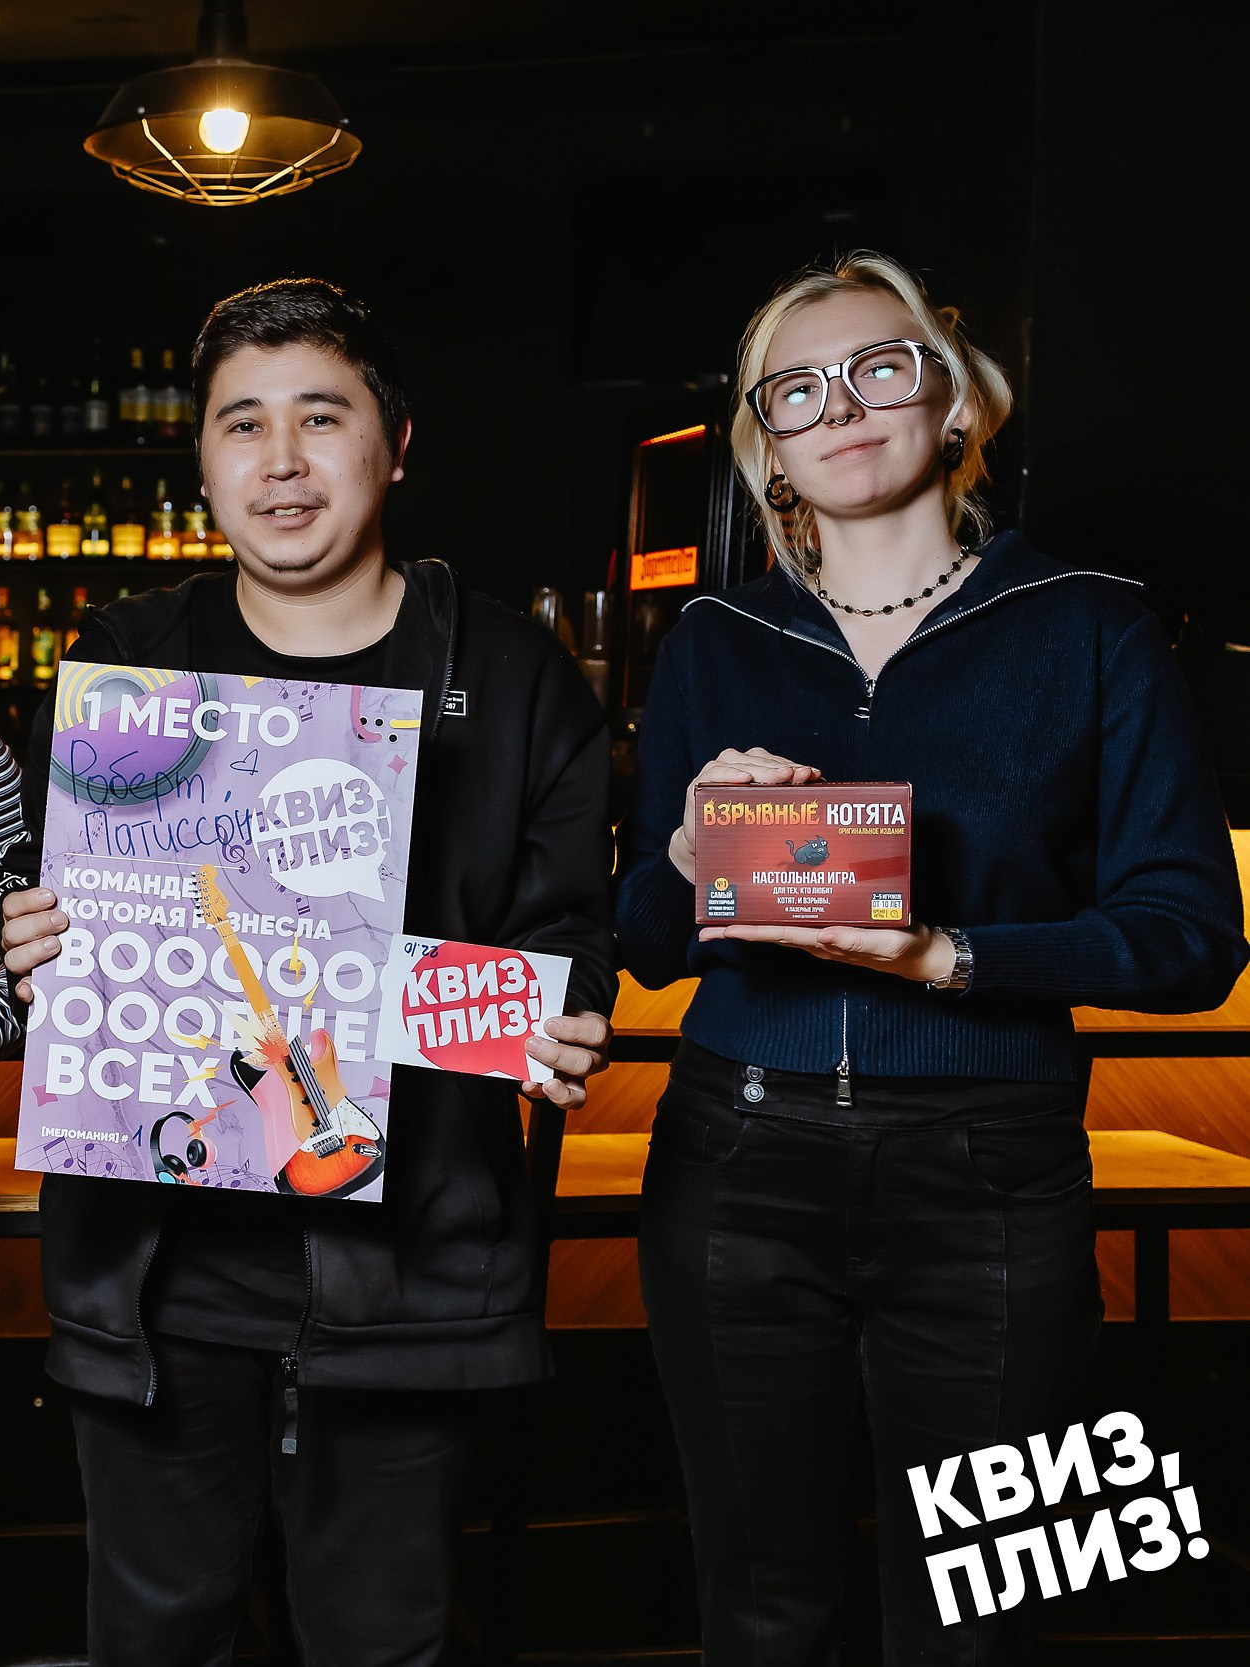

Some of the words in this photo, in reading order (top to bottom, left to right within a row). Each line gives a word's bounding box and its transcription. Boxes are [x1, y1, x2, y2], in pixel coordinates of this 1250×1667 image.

[84, 691, 102, 731] 1
[118, 694, 299, 747] МЕСТО
[258, 778, 387, 833] КВИЗ,
[703, 798, 820, 826] ВЗРЫВНЫЕ
[826, 802, 906, 825] КОТЯТА
[257, 818, 391, 874] ПЛИЗ!
[838, 827, 879, 835] ОРИГИНАЛЬНОЕ
[879, 827, 905, 835] ИЗДАНИЕ
[710, 890, 733, 899] САМЫЙ
[752, 871, 825, 884] НАСТОЛЬНАЯ
[827, 871, 856, 884] ИГРА
[772, 886, 786, 895] ДЛЯ
[786, 886, 800, 895] ТЕХ,
[799, 886, 812, 895] КТО
[811, 886, 834, 895] ЛЮБИТ
[60, 898, 186, 928] КОТОРАЯ
[192, 904, 333, 941] РЗНЕСЛА
[405, 957, 540, 1008] КВИЗ,
[405, 997, 542, 1050] ПЛИЗ!
[45, 1043, 221, 1109] ВСЕХ
[41, 1126, 120, 1144] [МЕЛОМАНИЯ]
